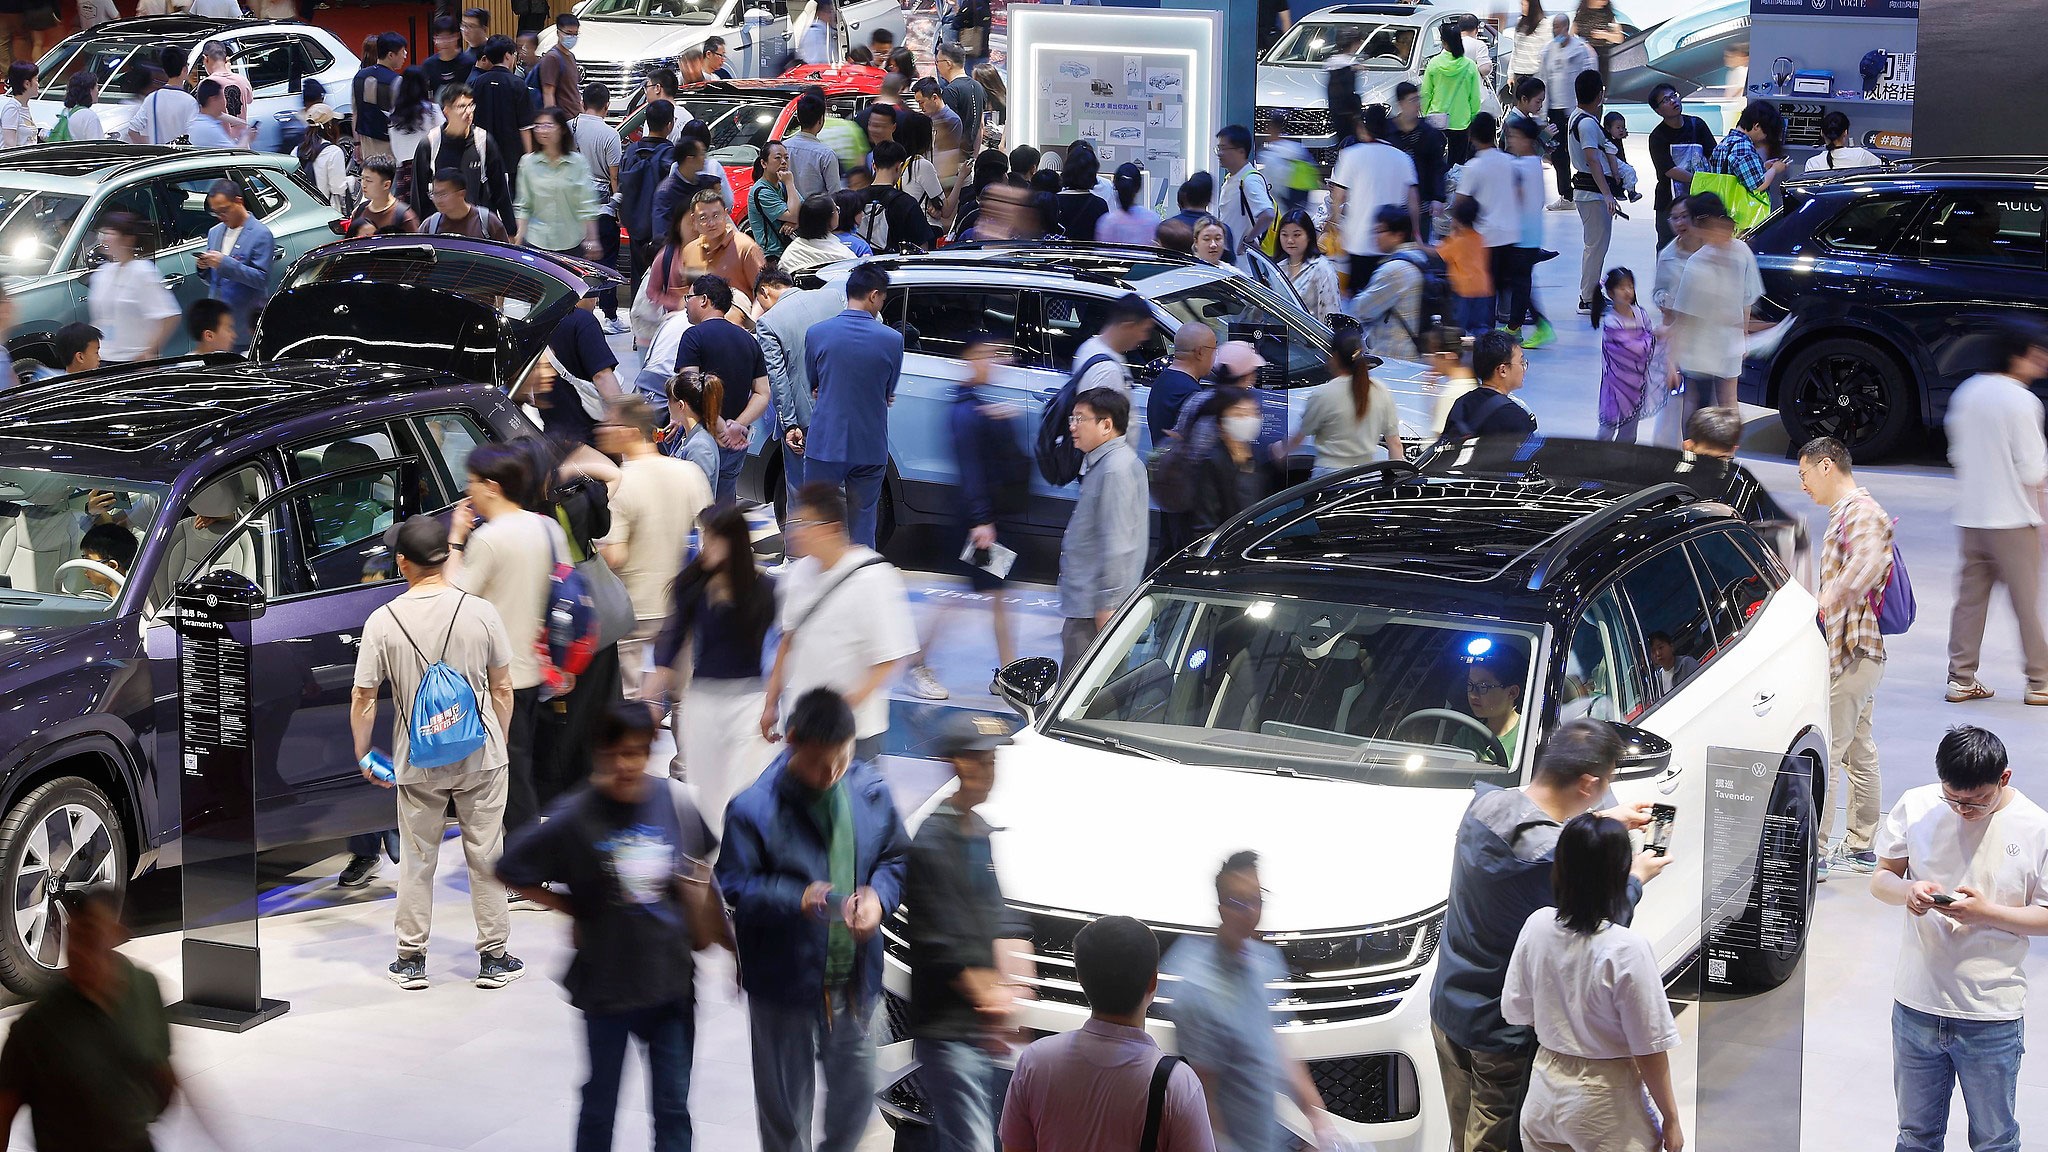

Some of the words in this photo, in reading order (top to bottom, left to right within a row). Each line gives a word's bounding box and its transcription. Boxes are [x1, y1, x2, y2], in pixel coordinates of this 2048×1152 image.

[181, 618, 212, 628] Teramont
[212, 621, 223, 630] Pro
[1714, 790, 1754, 802] Tavendor
